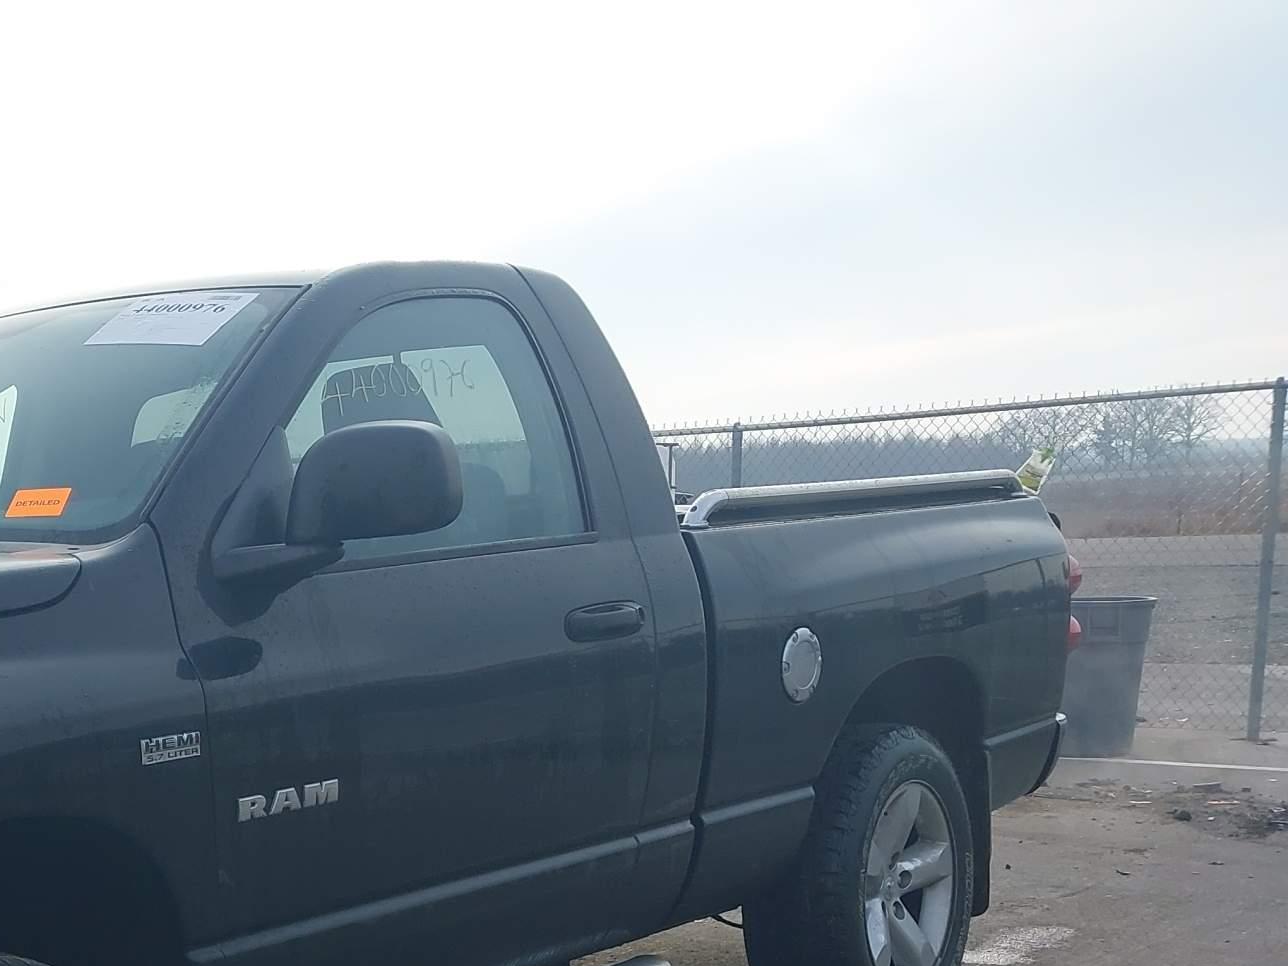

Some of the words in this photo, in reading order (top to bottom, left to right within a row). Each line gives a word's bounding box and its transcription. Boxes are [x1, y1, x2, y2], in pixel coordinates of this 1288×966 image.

[132, 303, 230, 314] 44000976
[320, 357, 476, 416] 44000976
[15, 499, 61, 507] DETAILED
[144, 732, 200, 754] HEMI
[145, 753, 165, 763] 5.7
[167, 747, 200, 759] LITER
[237, 778, 340, 823] RAM
